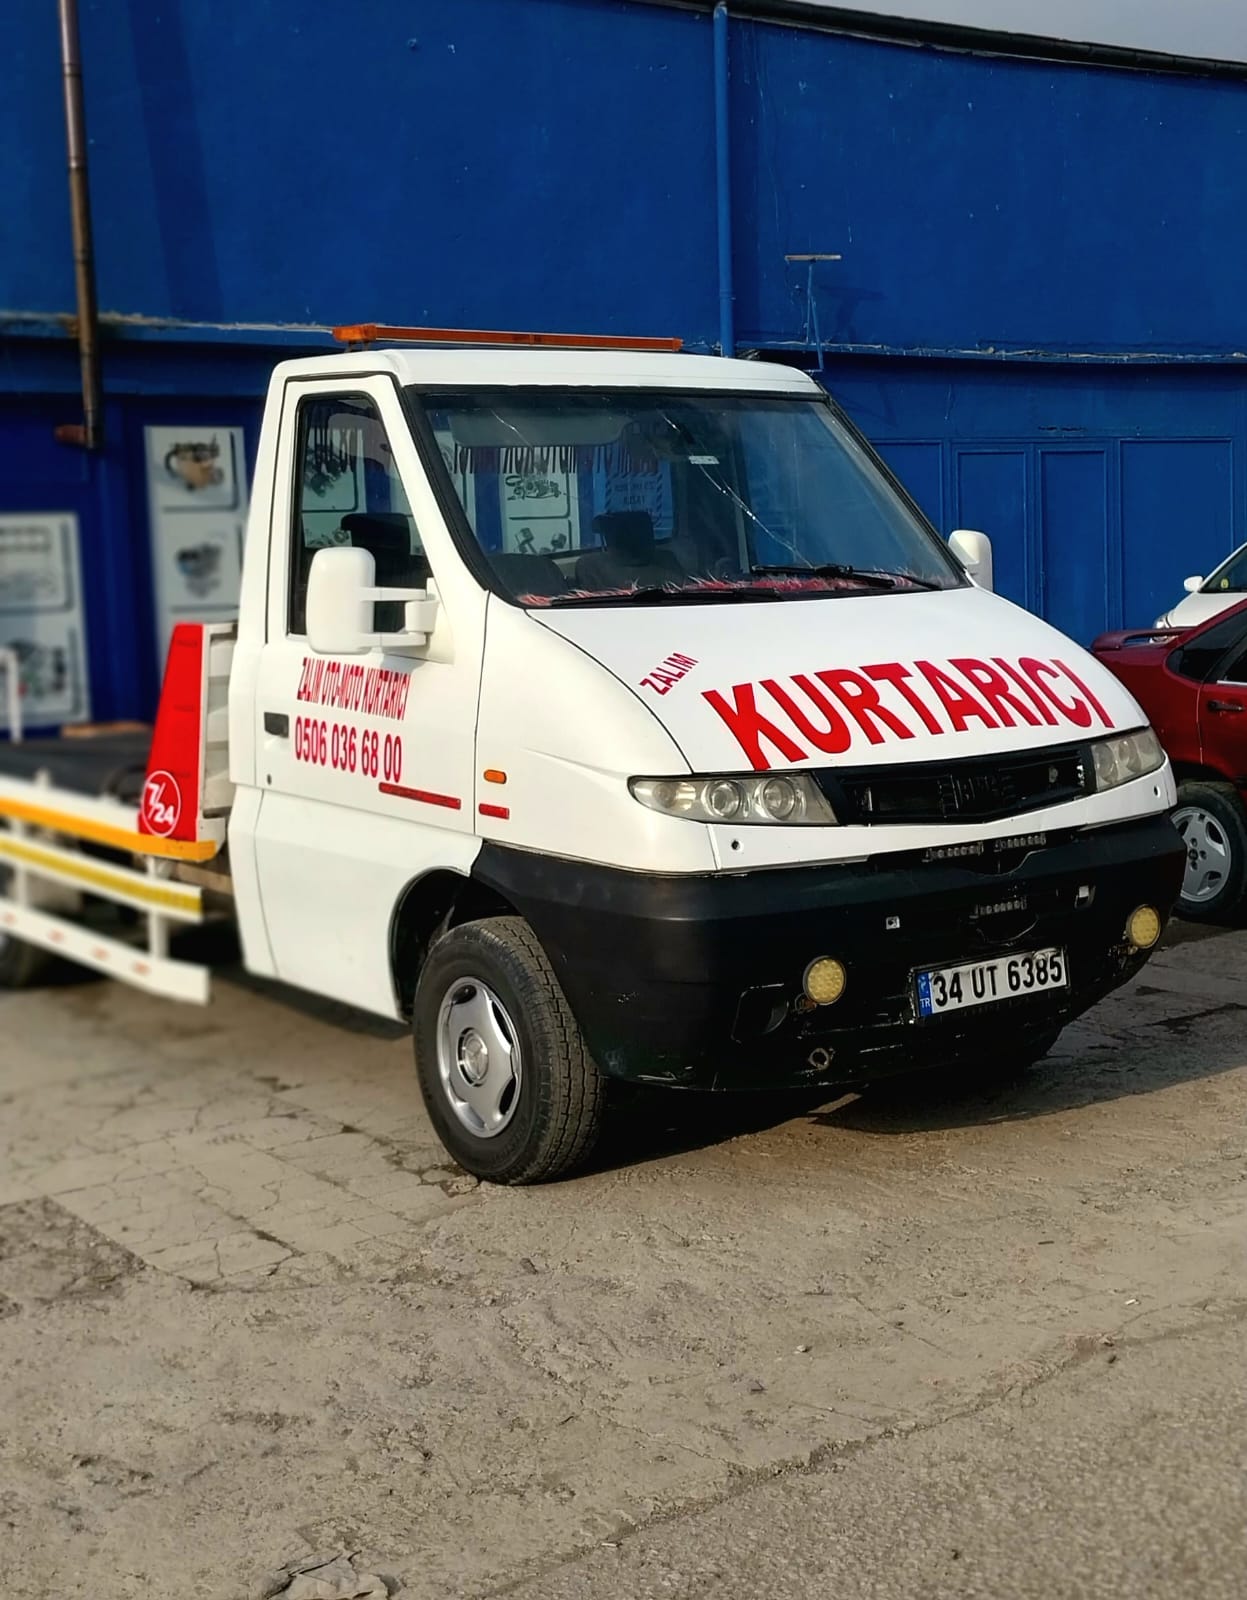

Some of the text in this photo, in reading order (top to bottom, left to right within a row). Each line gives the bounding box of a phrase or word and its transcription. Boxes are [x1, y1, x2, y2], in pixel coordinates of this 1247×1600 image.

[297, 657, 325, 703] ZALIM
[361, 667, 411, 721] KURTARICI
[640, 652, 699, 696] ZALIM
[701, 657, 1115, 771] KURTARICI
[295, 716, 402, 783] 0506 036 68 00
[147, 782, 175, 825] 7/24
[919, 953, 1063, 1009] TR 34 UT 6385
